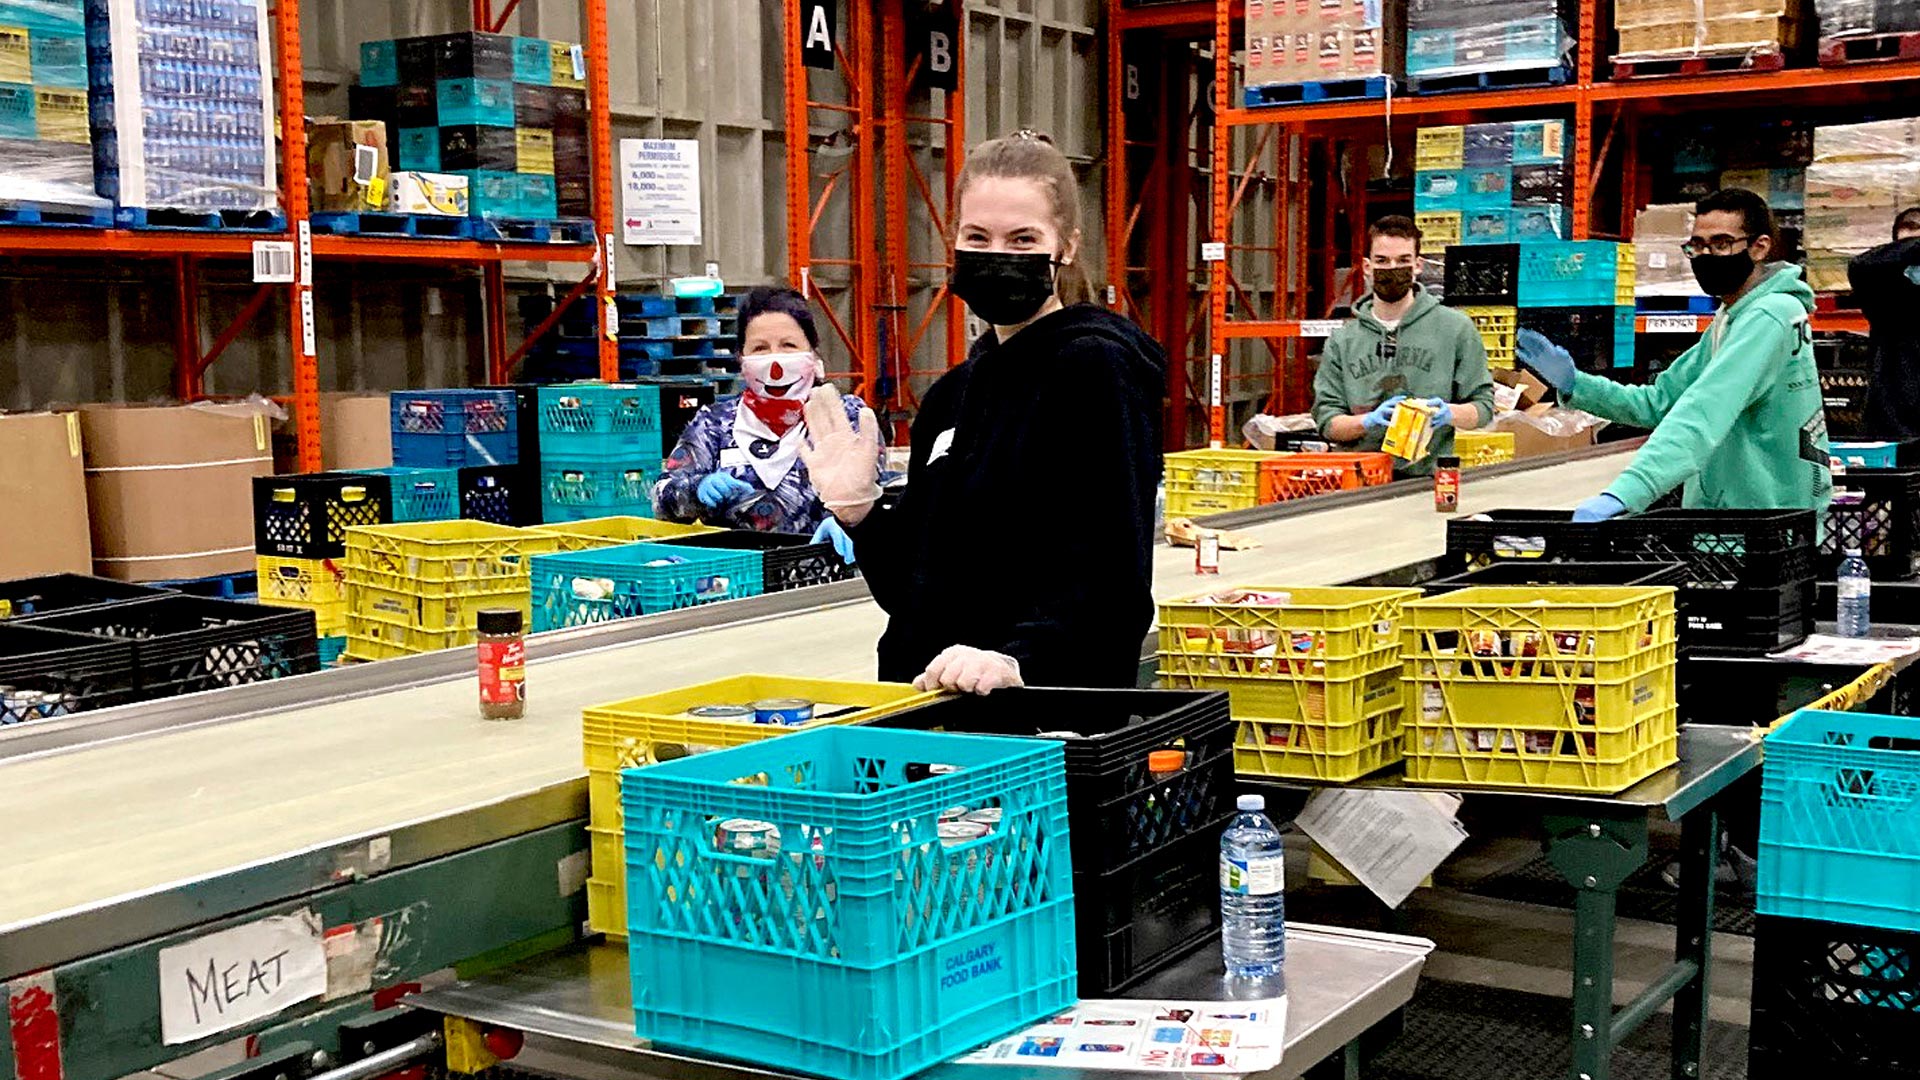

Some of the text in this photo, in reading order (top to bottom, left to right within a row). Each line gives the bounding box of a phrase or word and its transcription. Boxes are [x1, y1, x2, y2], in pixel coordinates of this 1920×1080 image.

[806, 5, 832, 52] A
[930, 31, 951, 72] B
[1127, 64, 1140, 99] B
[638, 151, 681, 161] PERMISSIBLE
[643, 141, 676, 151] MAXIMUM
[941, 956, 1003, 991] FOOD BANK
[945, 941, 996, 971] CALGARY
[186, 949, 290, 1024] MEAT
